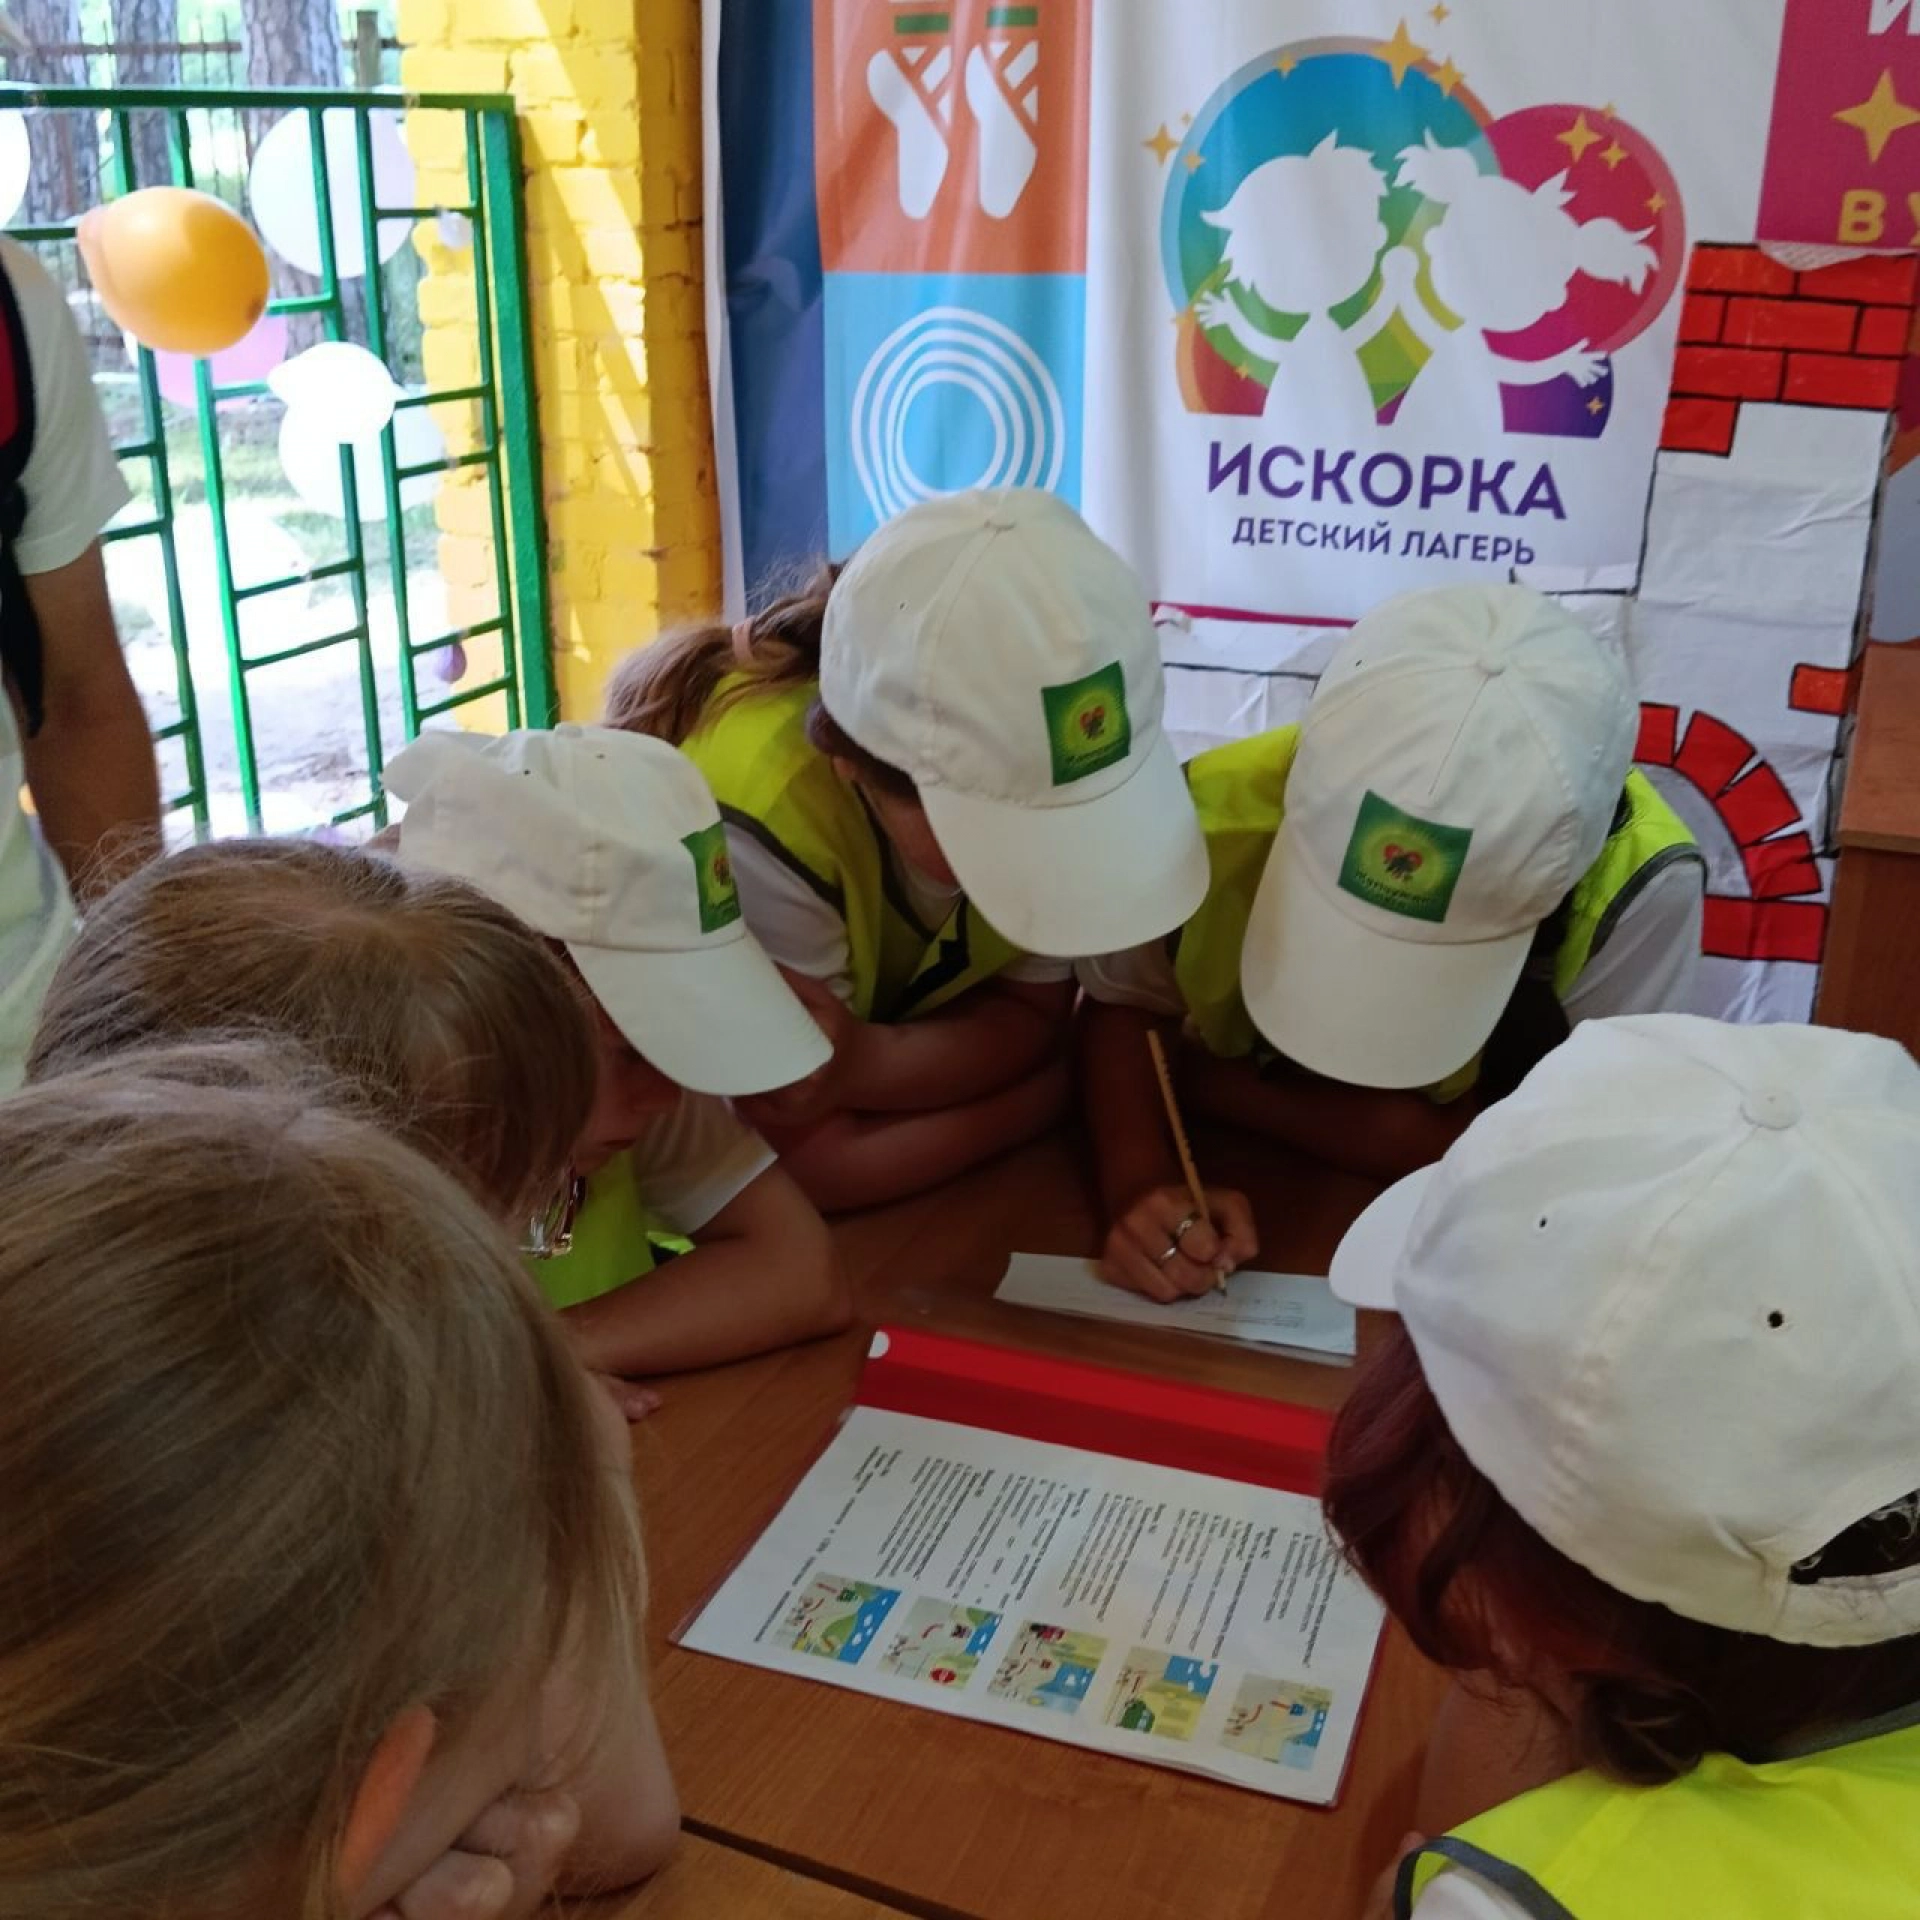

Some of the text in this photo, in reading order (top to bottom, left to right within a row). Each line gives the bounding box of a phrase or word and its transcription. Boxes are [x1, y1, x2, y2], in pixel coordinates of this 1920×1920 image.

[1206, 440, 1568, 520] ИСКОРКА
[1232, 515, 1536, 566] ДЕТСКИЙ ЛАГЕРЬ
